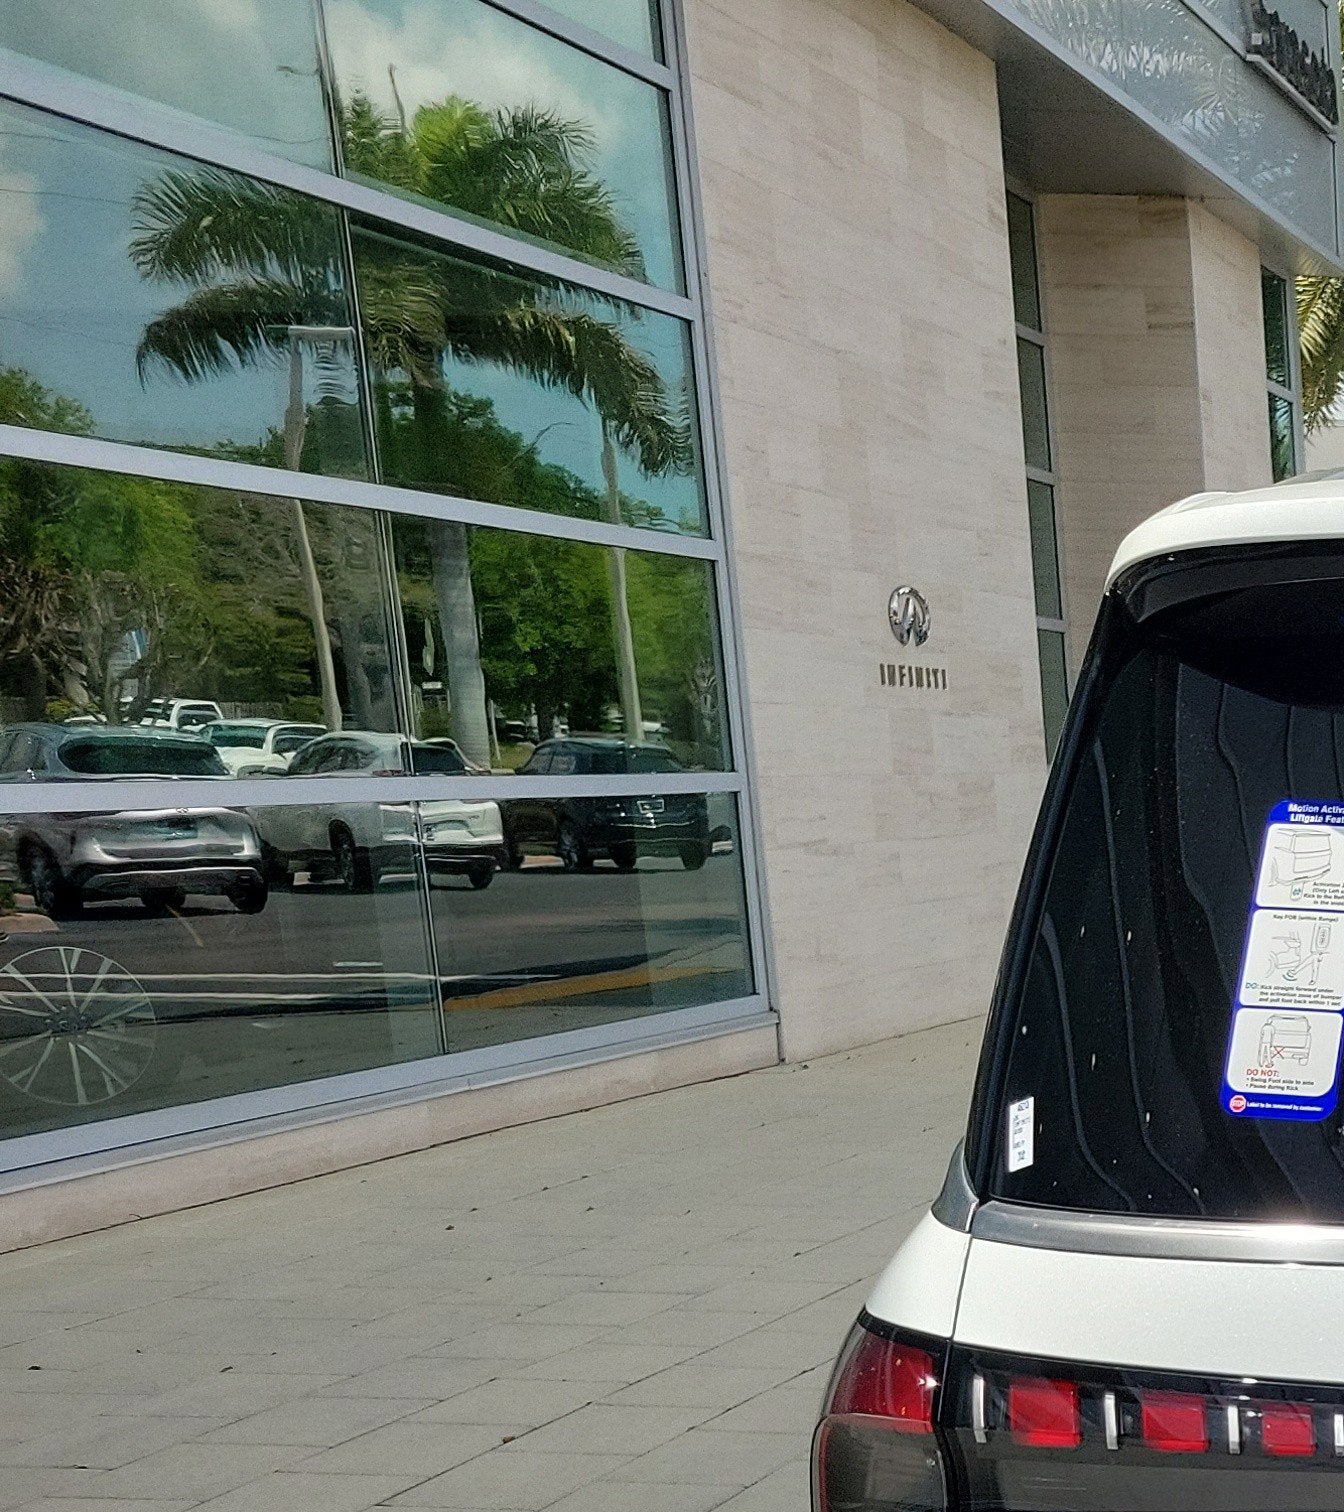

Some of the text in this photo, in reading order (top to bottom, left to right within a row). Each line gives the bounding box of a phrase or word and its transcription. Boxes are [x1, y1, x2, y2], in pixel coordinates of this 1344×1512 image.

[880, 663, 947, 690] INFINITI
[1288, 803, 1319, 813] Motion
[1290, 813, 1323, 823] Liftgate
[1246, 1068, 1258, 1076] DO
